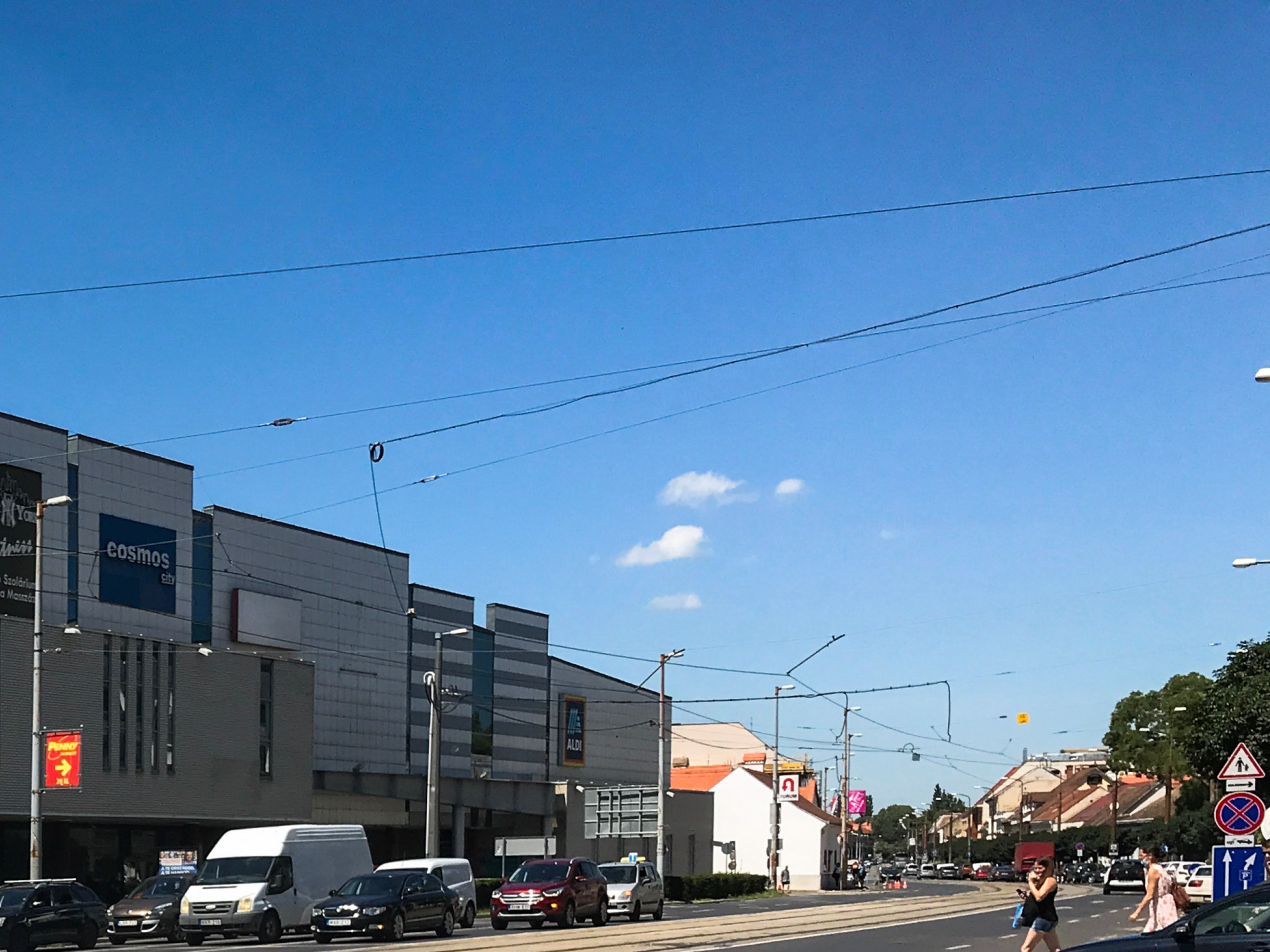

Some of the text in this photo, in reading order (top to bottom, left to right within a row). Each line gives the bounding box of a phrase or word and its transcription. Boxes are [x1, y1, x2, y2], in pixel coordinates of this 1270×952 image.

[106, 541, 170, 570] cosmos
[47, 741, 79, 751] PENNY
[567, 738, 582, 752] ALDI
